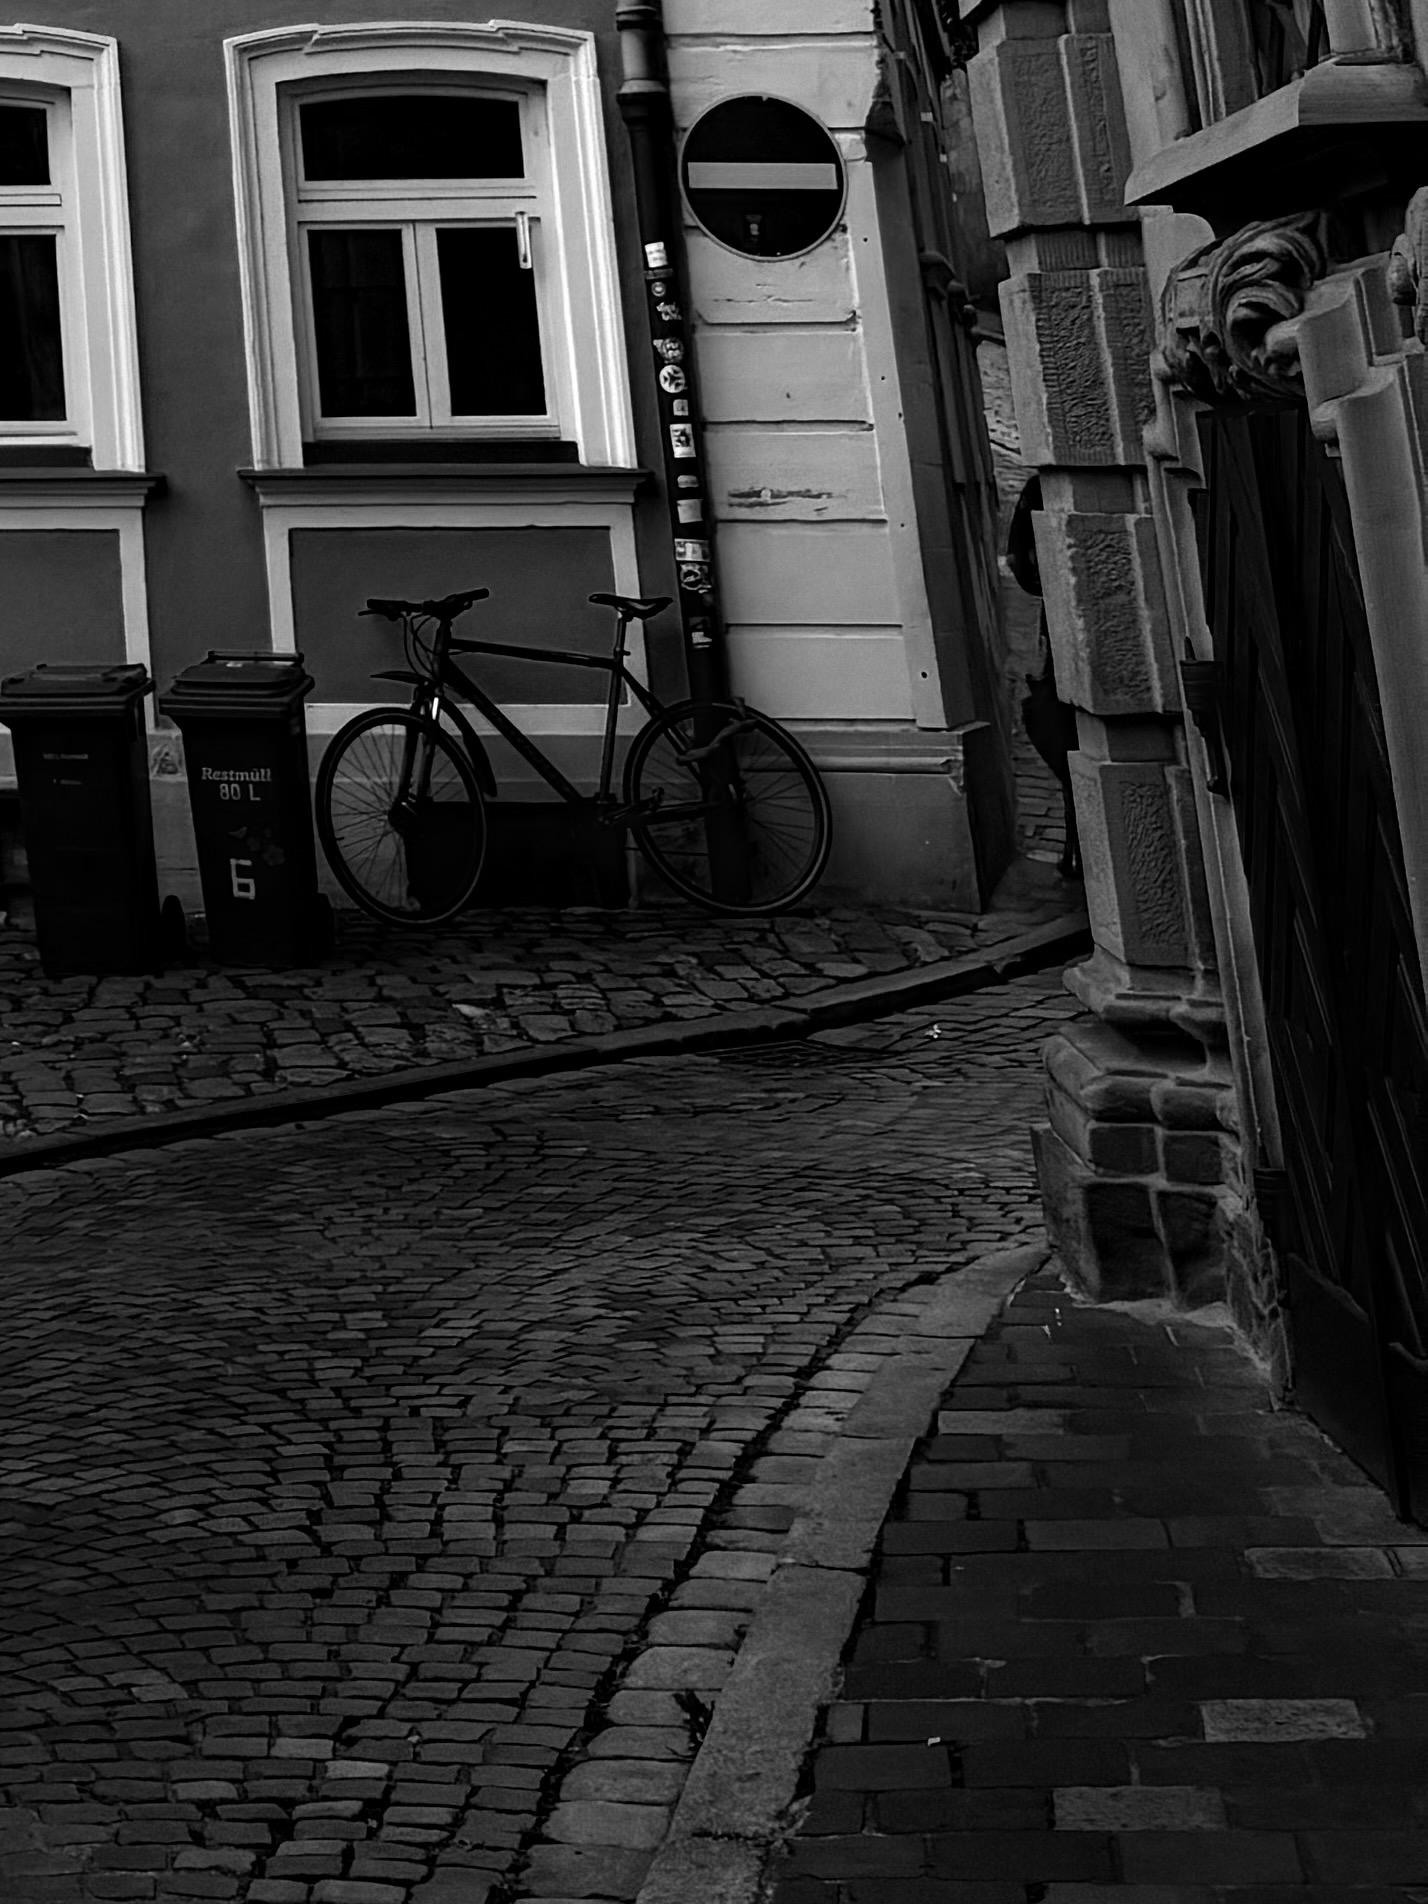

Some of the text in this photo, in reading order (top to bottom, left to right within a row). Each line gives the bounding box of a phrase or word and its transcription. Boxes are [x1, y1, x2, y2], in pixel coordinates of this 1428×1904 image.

[201, 766, 272, 782] Restmüll
[219, 783, 262, 801] 80 L
[229, 858, 256, 900] 6
